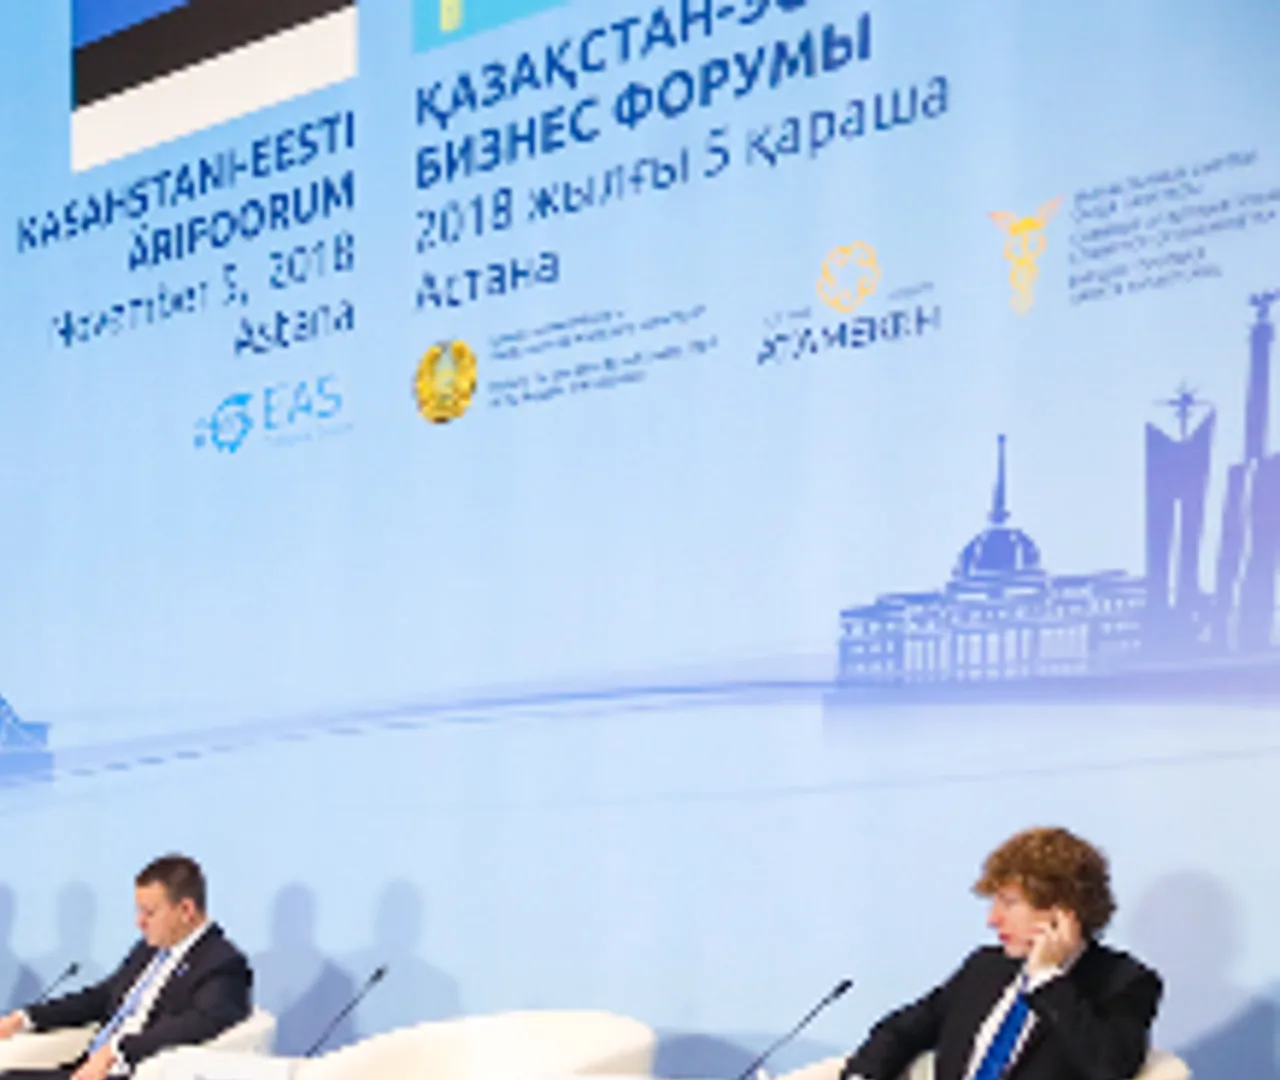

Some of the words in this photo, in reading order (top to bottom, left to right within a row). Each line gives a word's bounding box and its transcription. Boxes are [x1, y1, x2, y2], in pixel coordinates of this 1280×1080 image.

[415, 96, 601, 190] БИЗНЕС
[612, 10, 872, 130] ФОРУМЫ
[17, 110, 354, 253] KASAHSTANI-EESTI
[416, 187, 513, 254] 2018
[527, 147, 689, 222] жылғы
[703, 127, 731, 178] 5
[745, 75, 949, 167] қараша
[128, 170, 354, 273] ÄRIFOORUM
[269, 231, 354, 291] 2018
[415, 252, 561, 311] Астана
[234, 298, 354, 357] Astana
[263, 371, 343, 431] EAS
